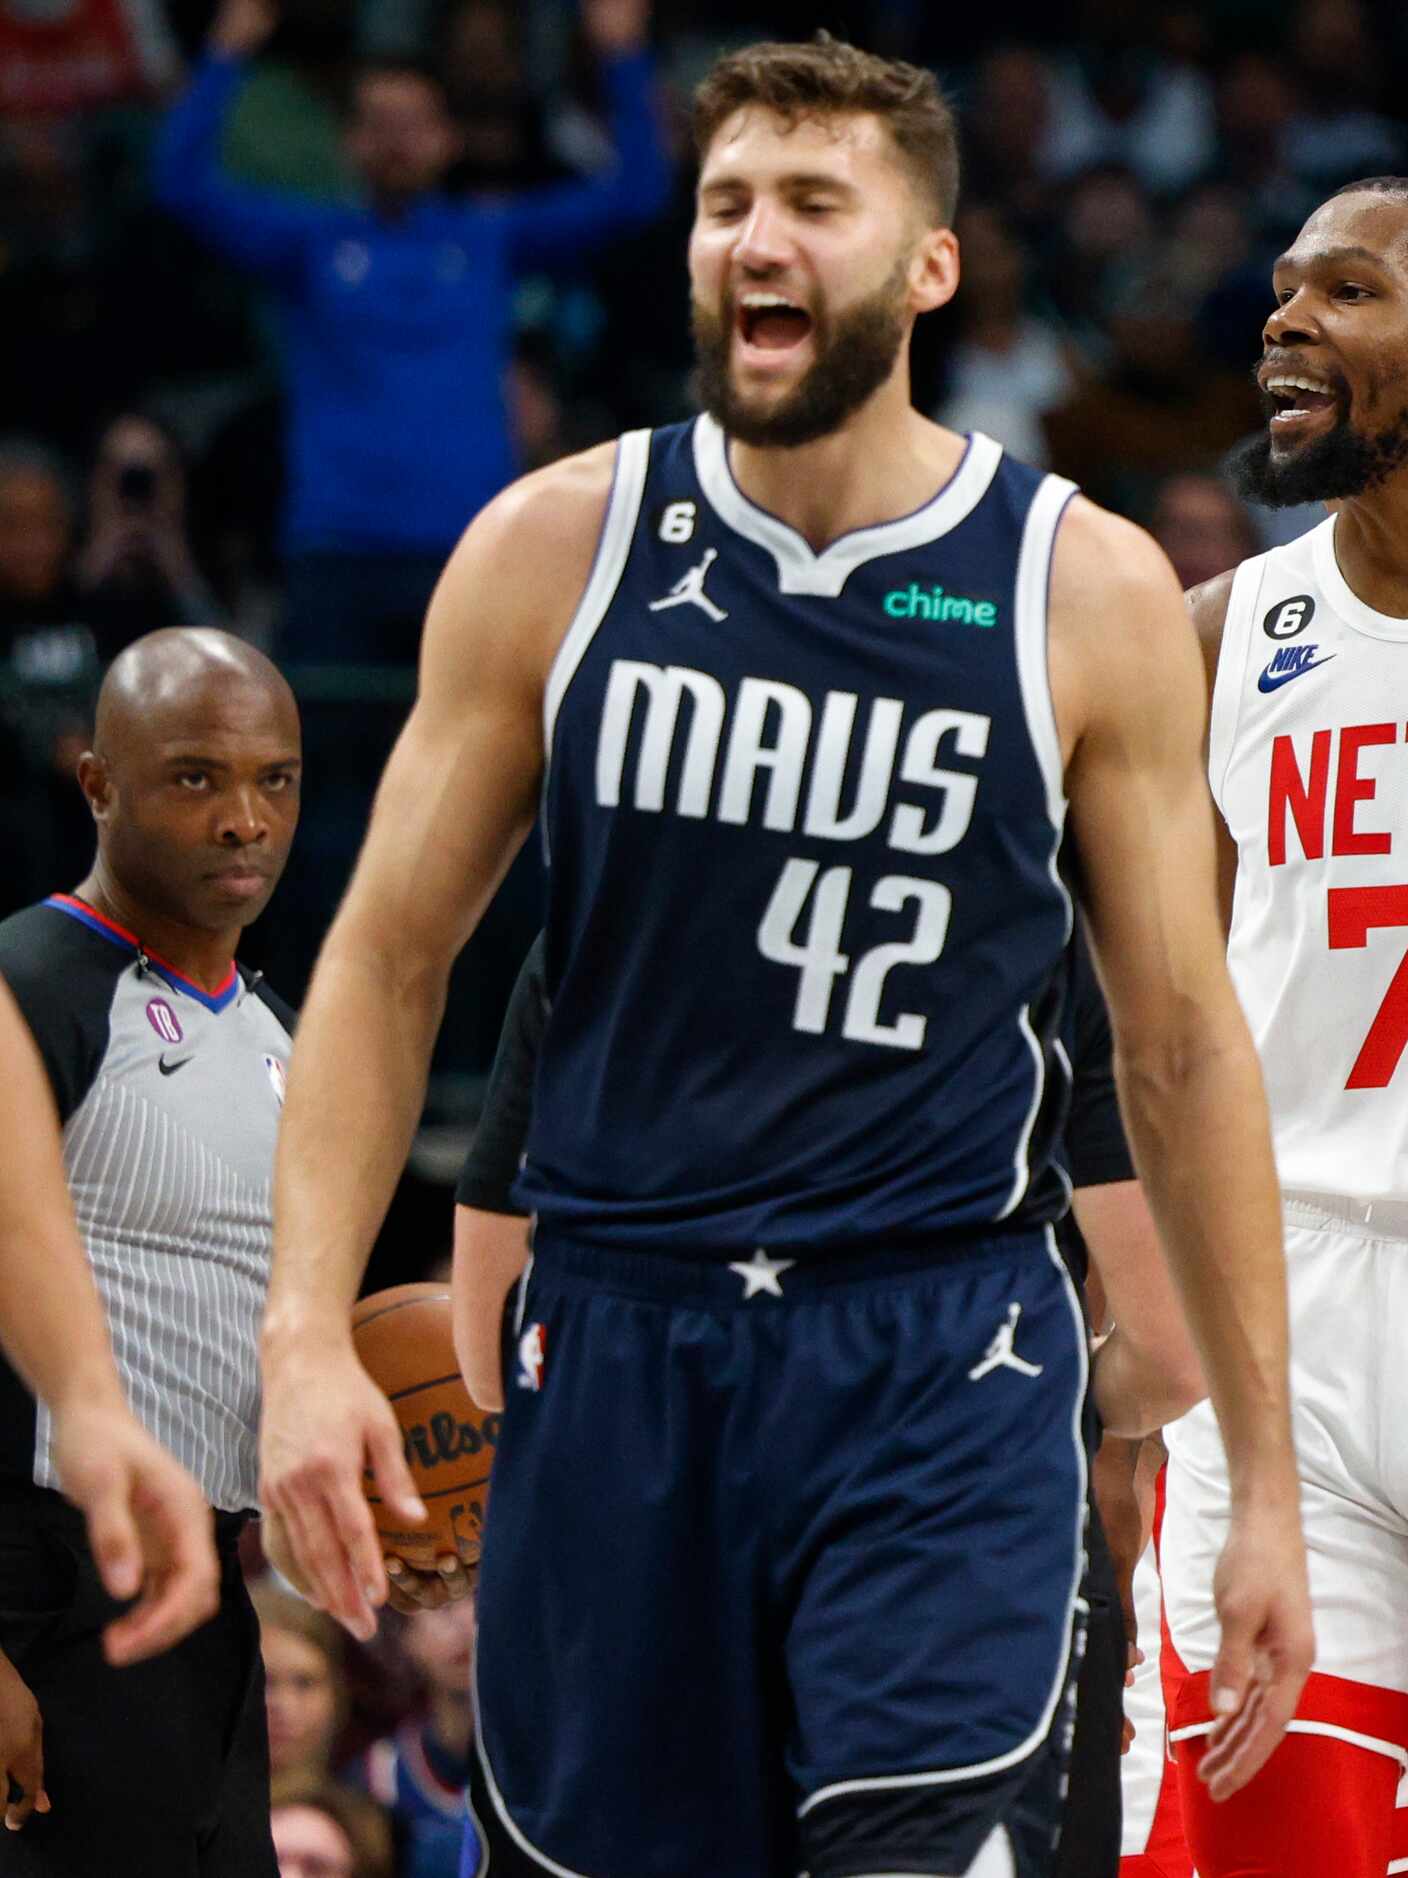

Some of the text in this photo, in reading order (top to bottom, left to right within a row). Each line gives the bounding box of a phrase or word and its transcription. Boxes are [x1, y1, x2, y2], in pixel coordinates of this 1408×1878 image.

[660, 502, 695, 542] 6
[884, 583, 997, 627] chime
[1274, 601, 1306, 635] 6
[1269, 644, 1318, 673] NIKE
[596, 660, 990, 855] MAVS
[758, 858, 951, 1050] 42
